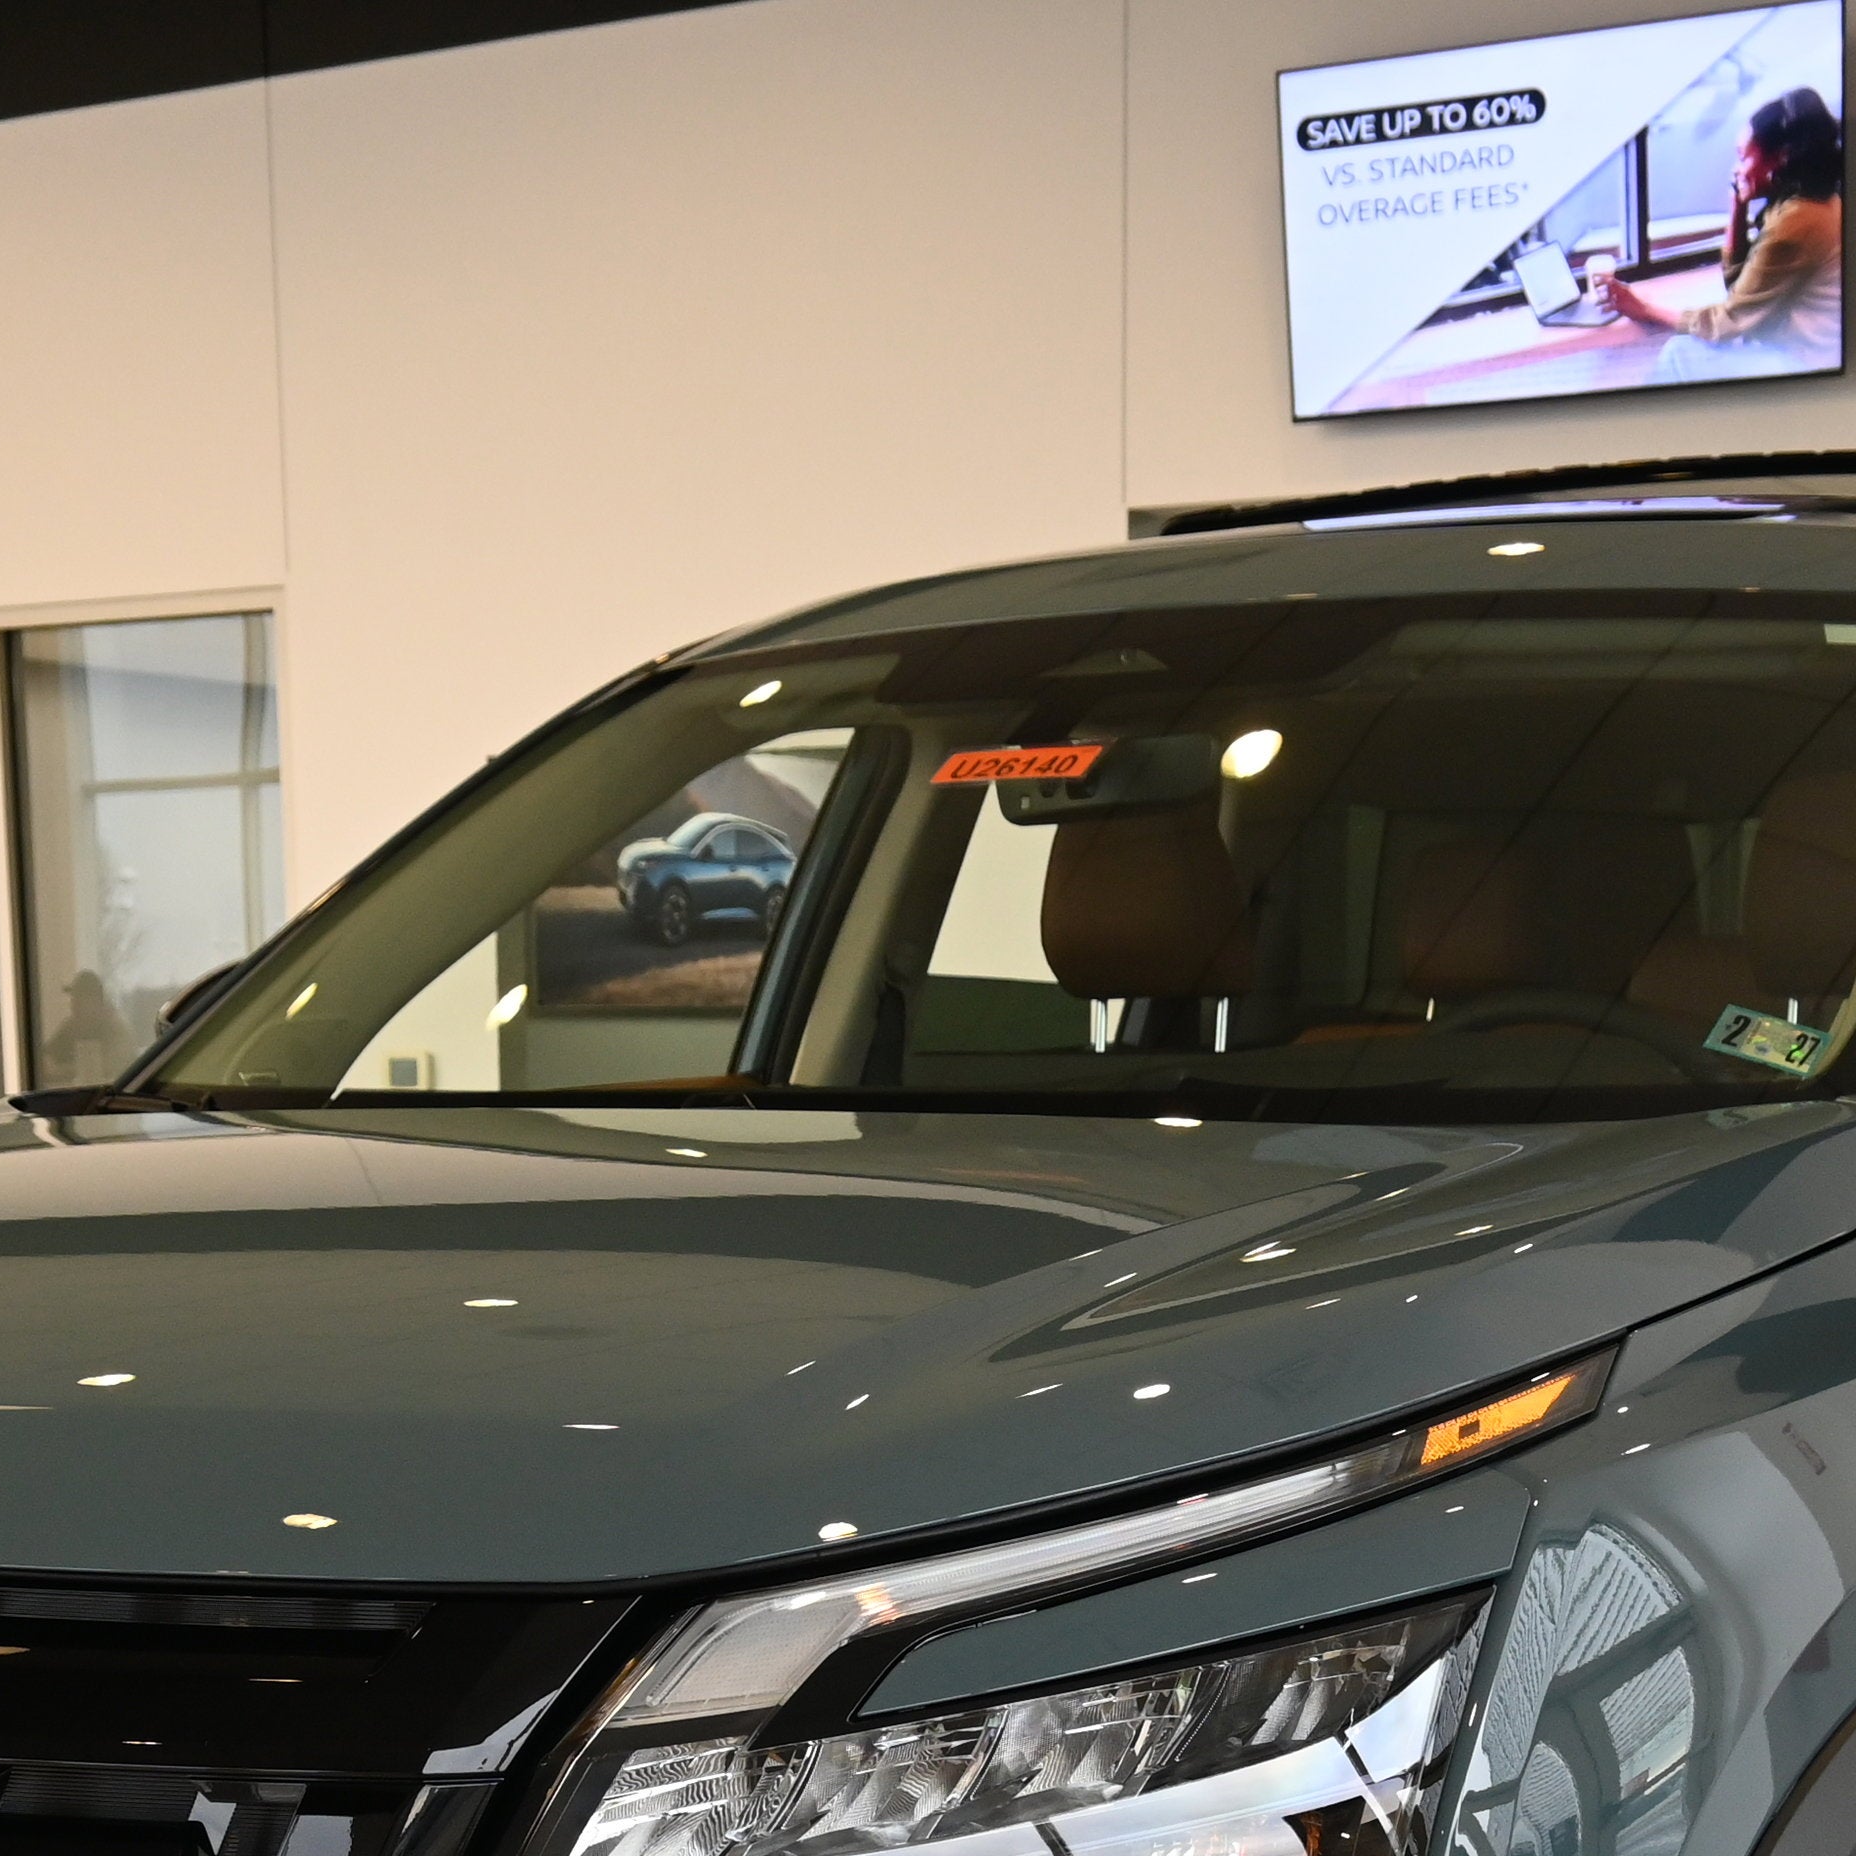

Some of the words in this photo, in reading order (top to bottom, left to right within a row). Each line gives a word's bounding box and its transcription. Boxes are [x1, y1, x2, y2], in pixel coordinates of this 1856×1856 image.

[1306, 114, 1377, 149] SAVE
[1381, 108, 1422, 138] UP
[1425, 103, 1468, 134] TO
[1472, 94, 1537, 128] 60%
[1369, 144, 1515, 181] STANDARD
[1317, 190, 1444, 226] OVERAGE
[950, 754, 1079, 779] U26140
[1721, 1014, 1752, 1047] 2
[1785, 1033, 1821, 1066] 27
